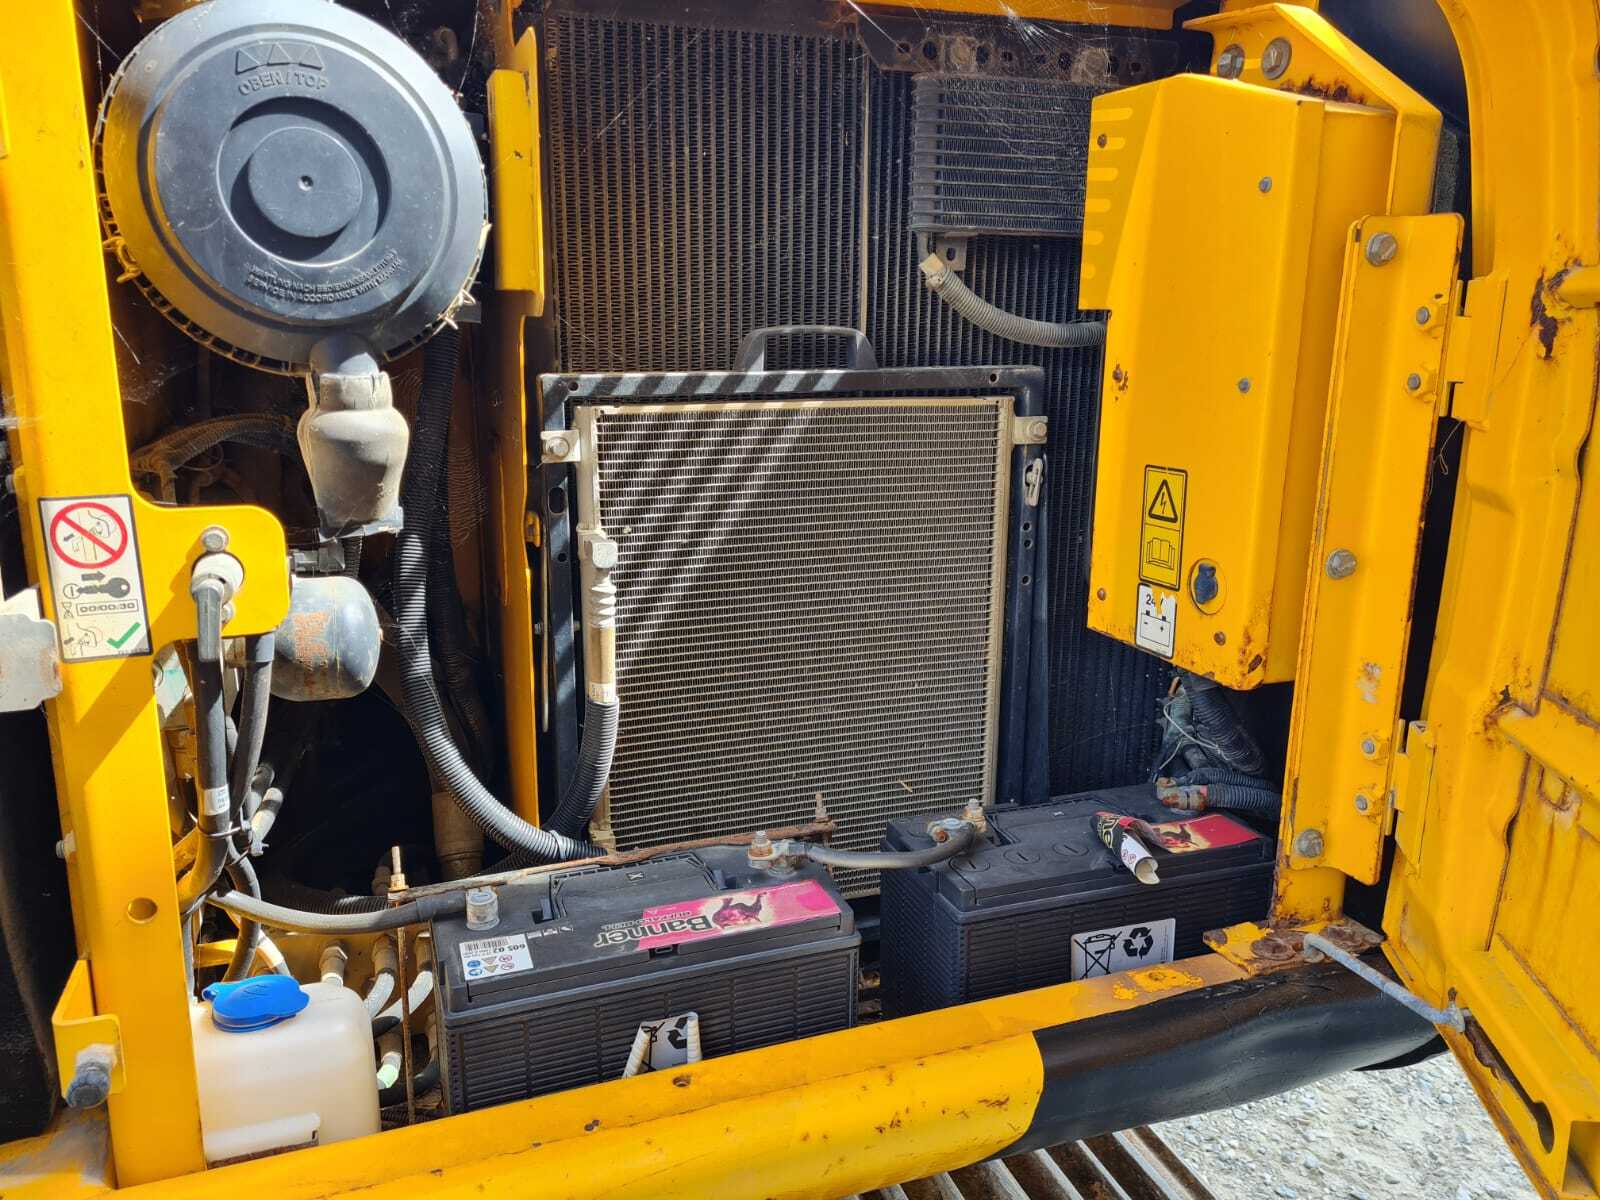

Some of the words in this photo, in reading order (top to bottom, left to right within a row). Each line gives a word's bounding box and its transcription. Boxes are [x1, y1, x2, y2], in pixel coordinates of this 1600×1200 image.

[238, 71, 282, 96] OBEN
[294, 70, 329, 91] TOP
[246, 274, 286, 299] SERVICE
[593, 914, 713, 949] Banner
